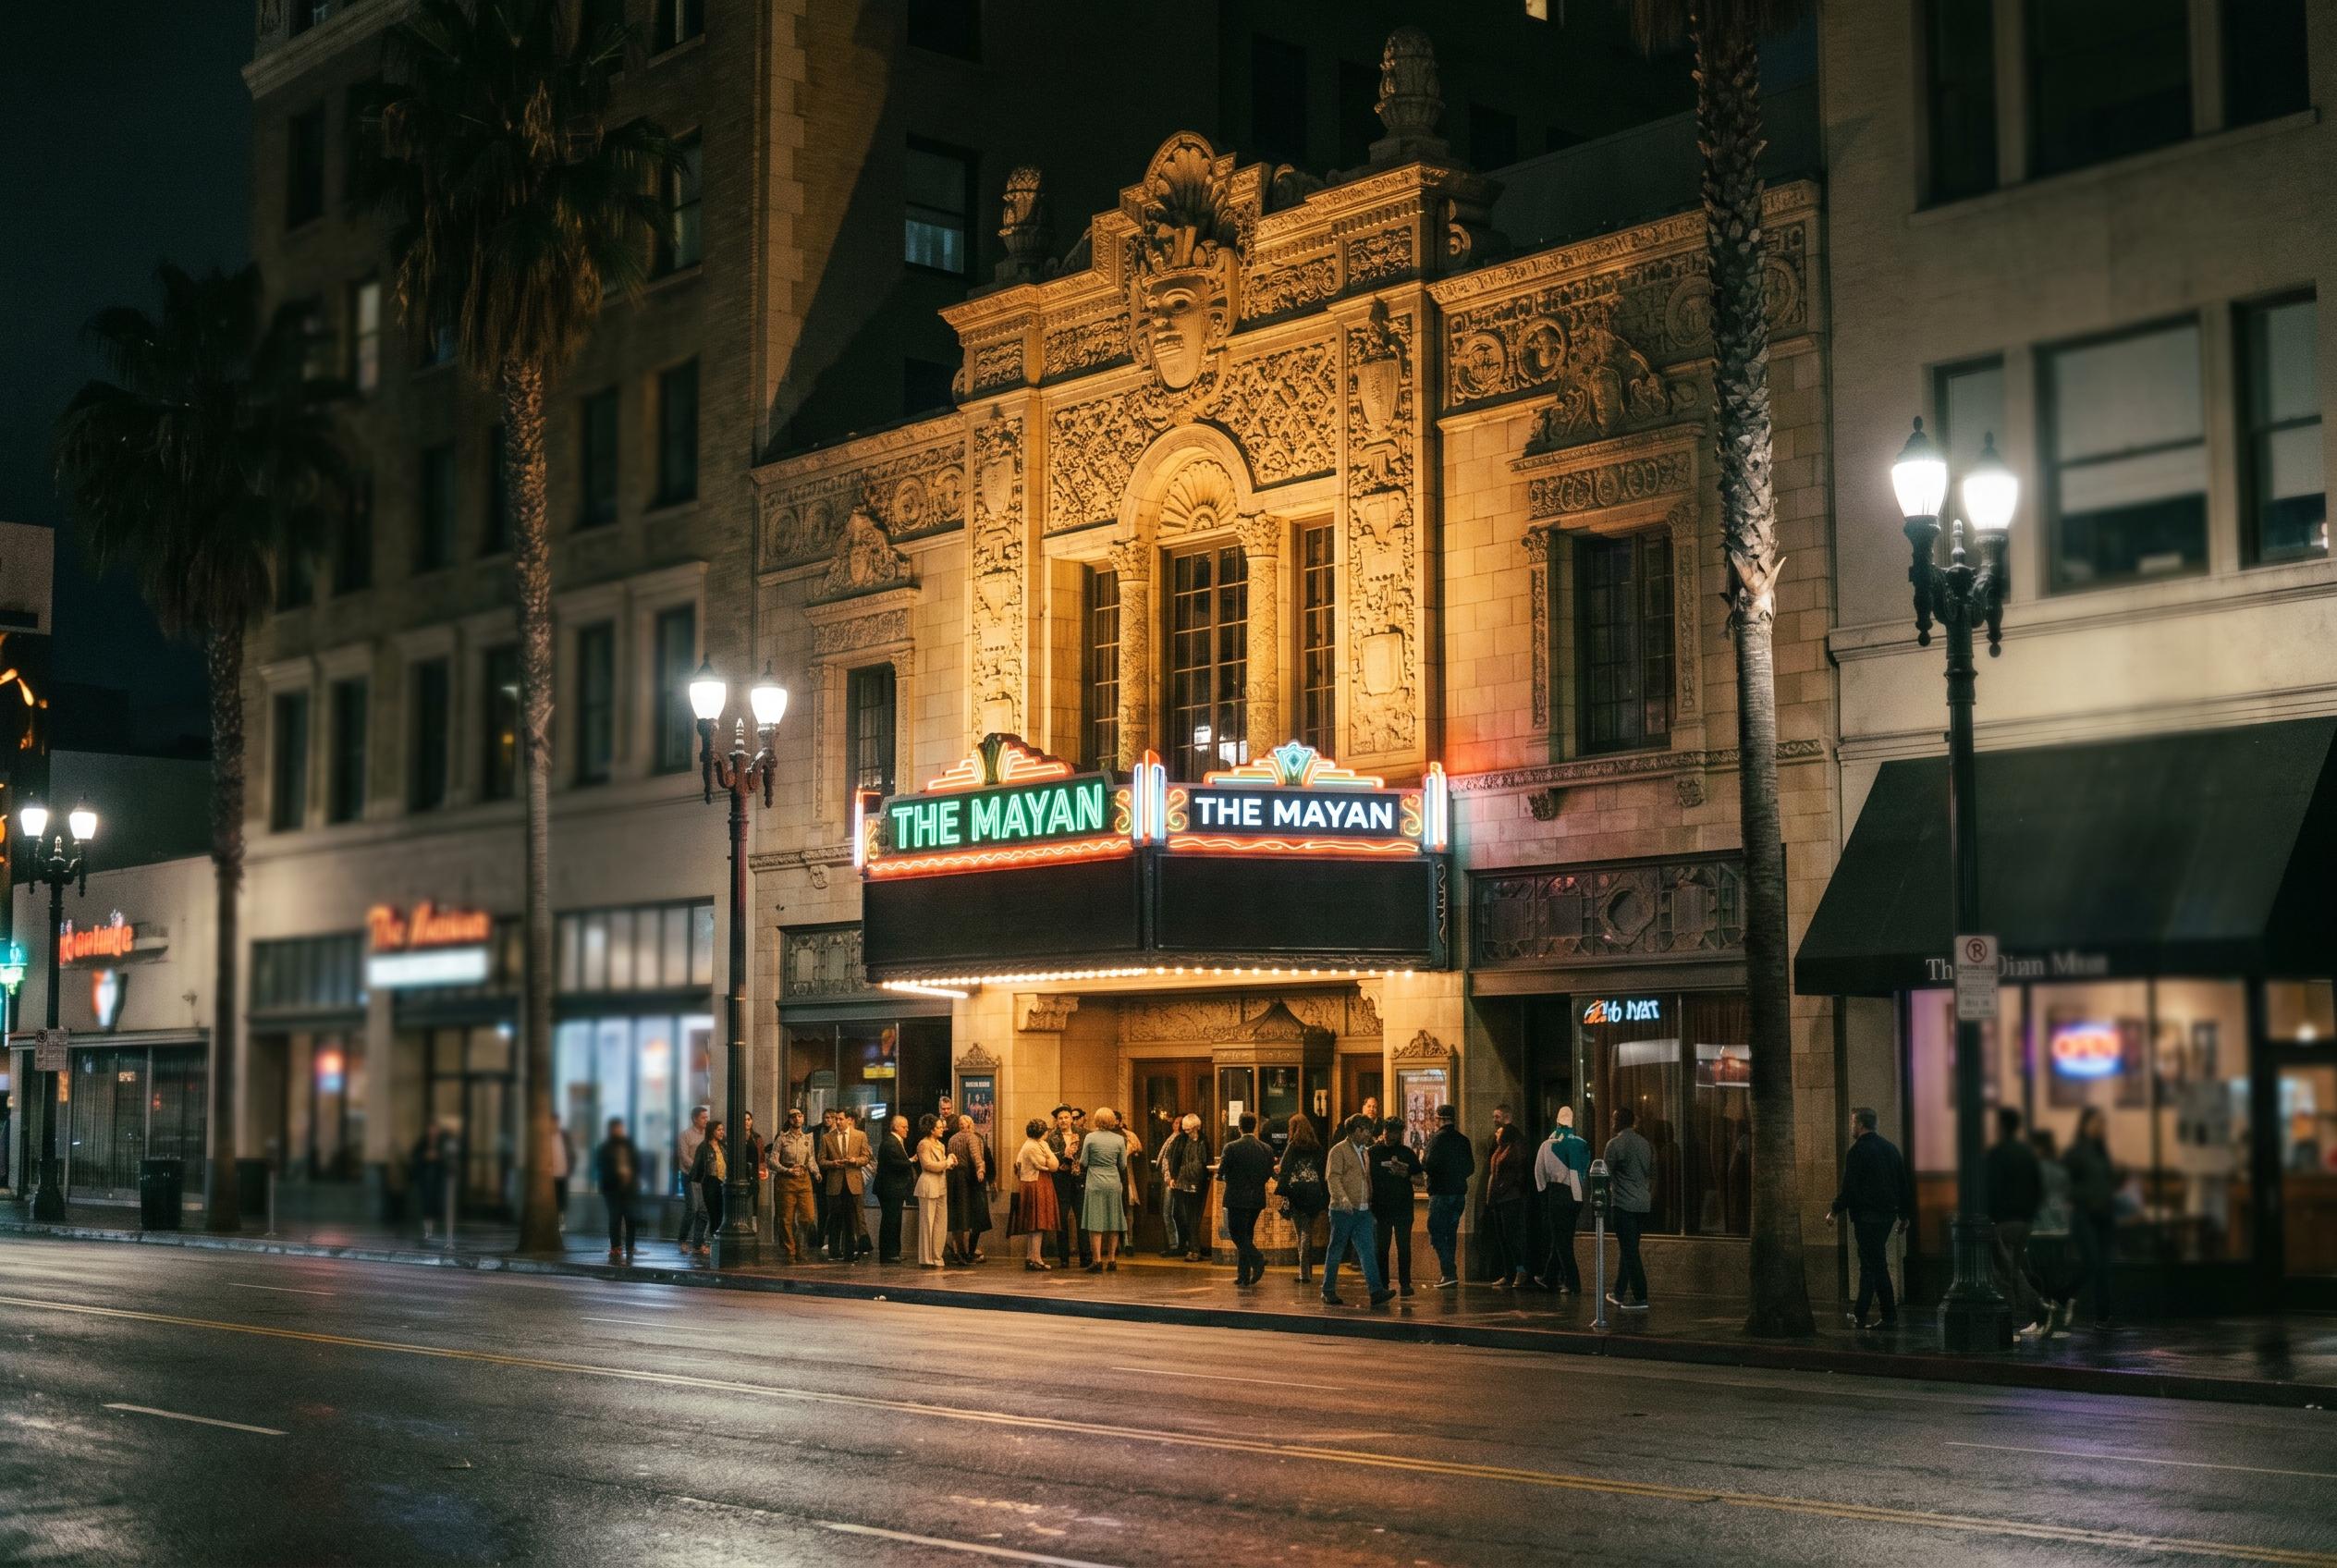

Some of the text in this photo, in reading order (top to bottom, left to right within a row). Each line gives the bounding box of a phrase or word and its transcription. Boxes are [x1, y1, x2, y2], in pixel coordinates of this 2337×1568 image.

[892, 784, 1103, 849] THE MAYAN
[1194, 797, 1392, 829] THE MAYAN
[1926, 958, 1954, 980] Th
